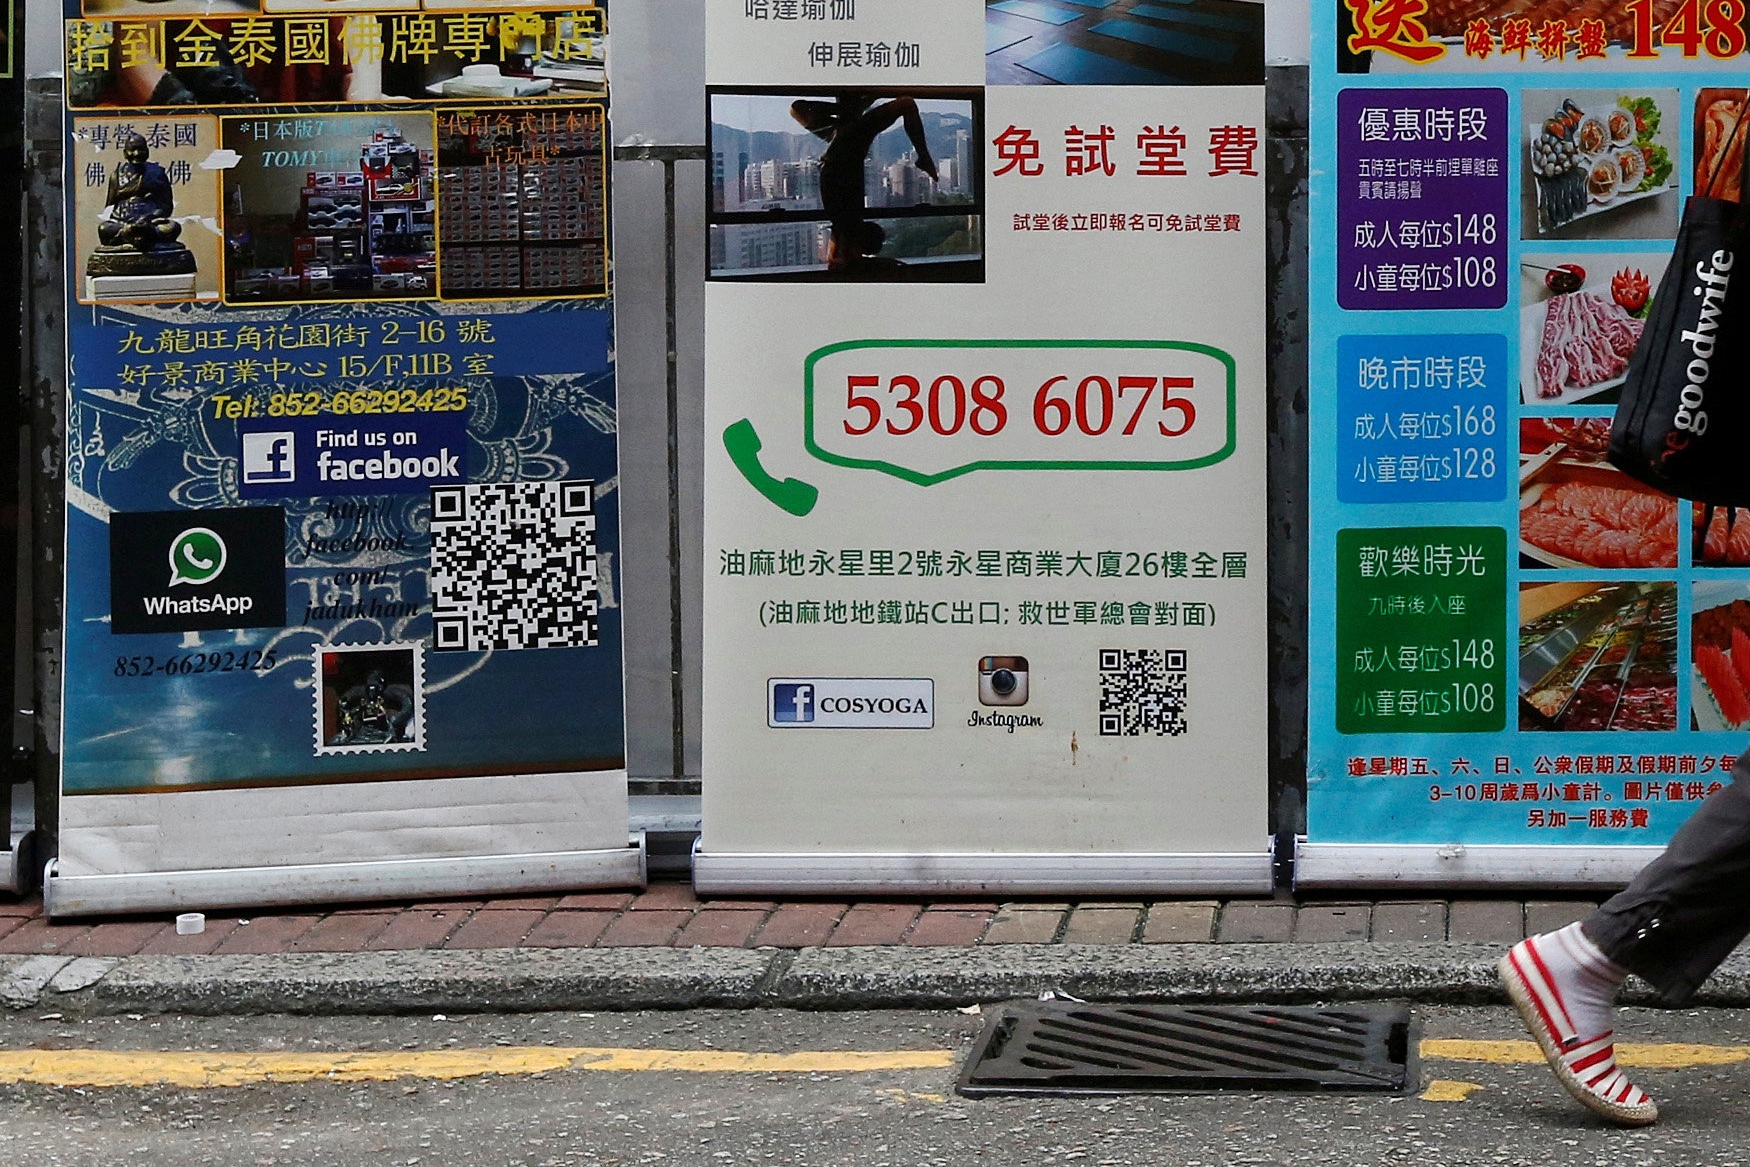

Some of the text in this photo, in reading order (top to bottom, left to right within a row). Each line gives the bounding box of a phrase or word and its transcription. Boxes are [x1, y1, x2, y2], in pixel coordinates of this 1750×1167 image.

[807, 41, 921, 69] 伸展瑜伽
[1463, 16, 1608, 61] 海鮮拼盤
[1357, 105, 1489, 144] 優惠時段
[991, 123, 1260, 178] 免試堂費
[1013, 212, 1241, 233] 試堂後立即報名可免試堂費
[1353, 213, 1498, 249] 成人每位$148
[1353, 255, 1498, 292] 小童每位$108
[118, 318, 496, 355] 九龍旺角花園街 2-16 號
[1674, 247, 1735, 438] goodwife
[118, 357, 327, 387] 好景商業中心
[1358, 354, 1488, 392] 晚市時段
[267, 388, 468, 418] 852-66292425
[842, 374, 1198, 438] 5308 6075
[316, 429, 418, 448] Find us on
[1353, 403, 1497, 442] 成人每位$168
[316, 449, 460, 482] facebook
[1353, 447, 1497, 485] 小童每位$128
[719, 548, 1249, 581] 油麻地永星里2號永星商業大廈26樓全層
[1358, 543, 1487, 580] 歡樂時光
[143, 594, 253, 617] WhatsApp
[1367, 594, 1467, 617] 九時後入座
[114, 648, 277, 678] 852-66292425
[1353, 637, 1496, 674] 成人每位$148
[819, 696, 929, 715] COSYOGA
[1353, 681, 1496, 719] 小童每位$108
[967, 710, 1044, 734] Instagram
[1526, 807, 1650, 830] 另加一服務費
